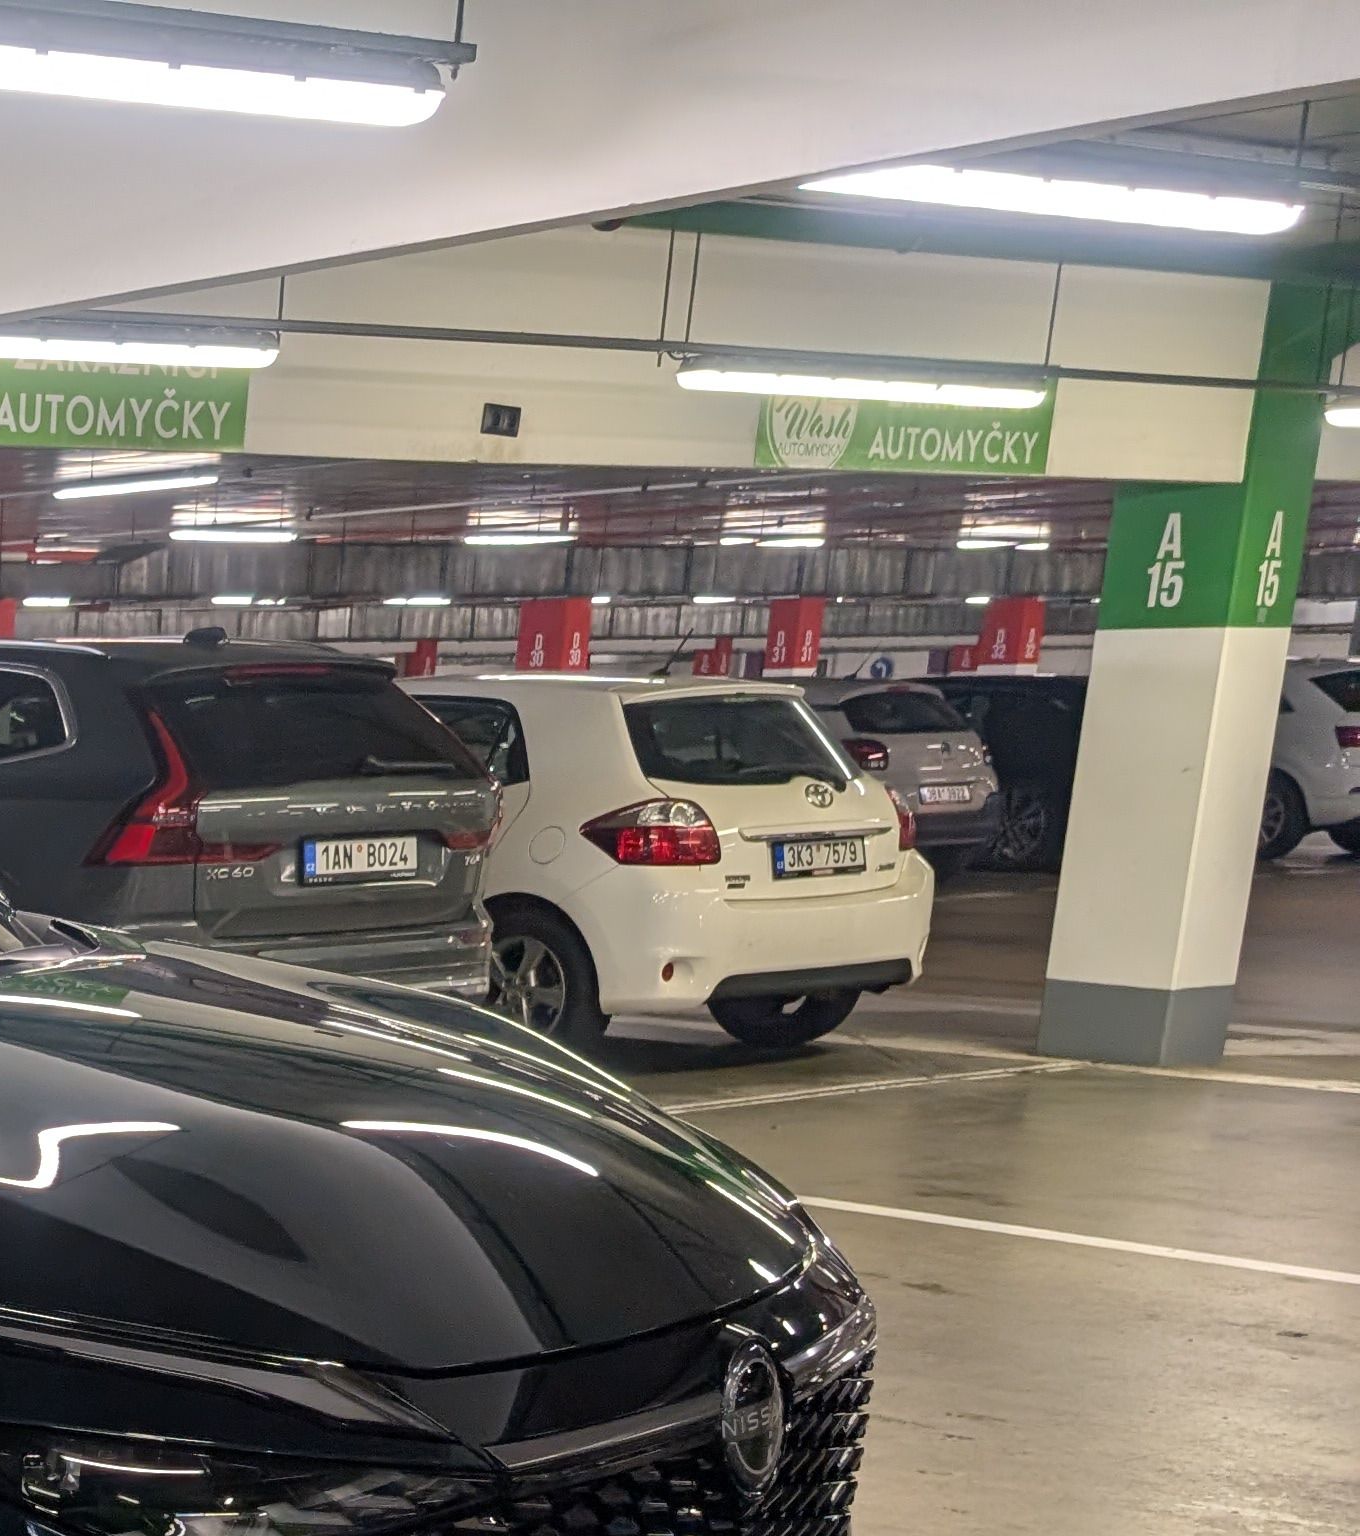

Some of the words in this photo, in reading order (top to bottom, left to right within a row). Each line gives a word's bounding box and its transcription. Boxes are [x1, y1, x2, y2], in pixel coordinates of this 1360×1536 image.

[785, 400, 852, 440] Wash
[868, 421, 1039, 464] AUTOMYČKY
[1156, 512, 1182, 560] A
[1265, 511, 1284, 558] A
[1147, 561, 1185, 608] 15
[1256, 560, 1282, 608] 15
[529, 650, 544, 667] 30
[772, 646, 786, 663] 31
[801, 646, 812, 662] 31
[321, 844, 353, 870] 1AN
[788, 845, 814, 867] 3K3
[823, 842, 857, 865] 7579
